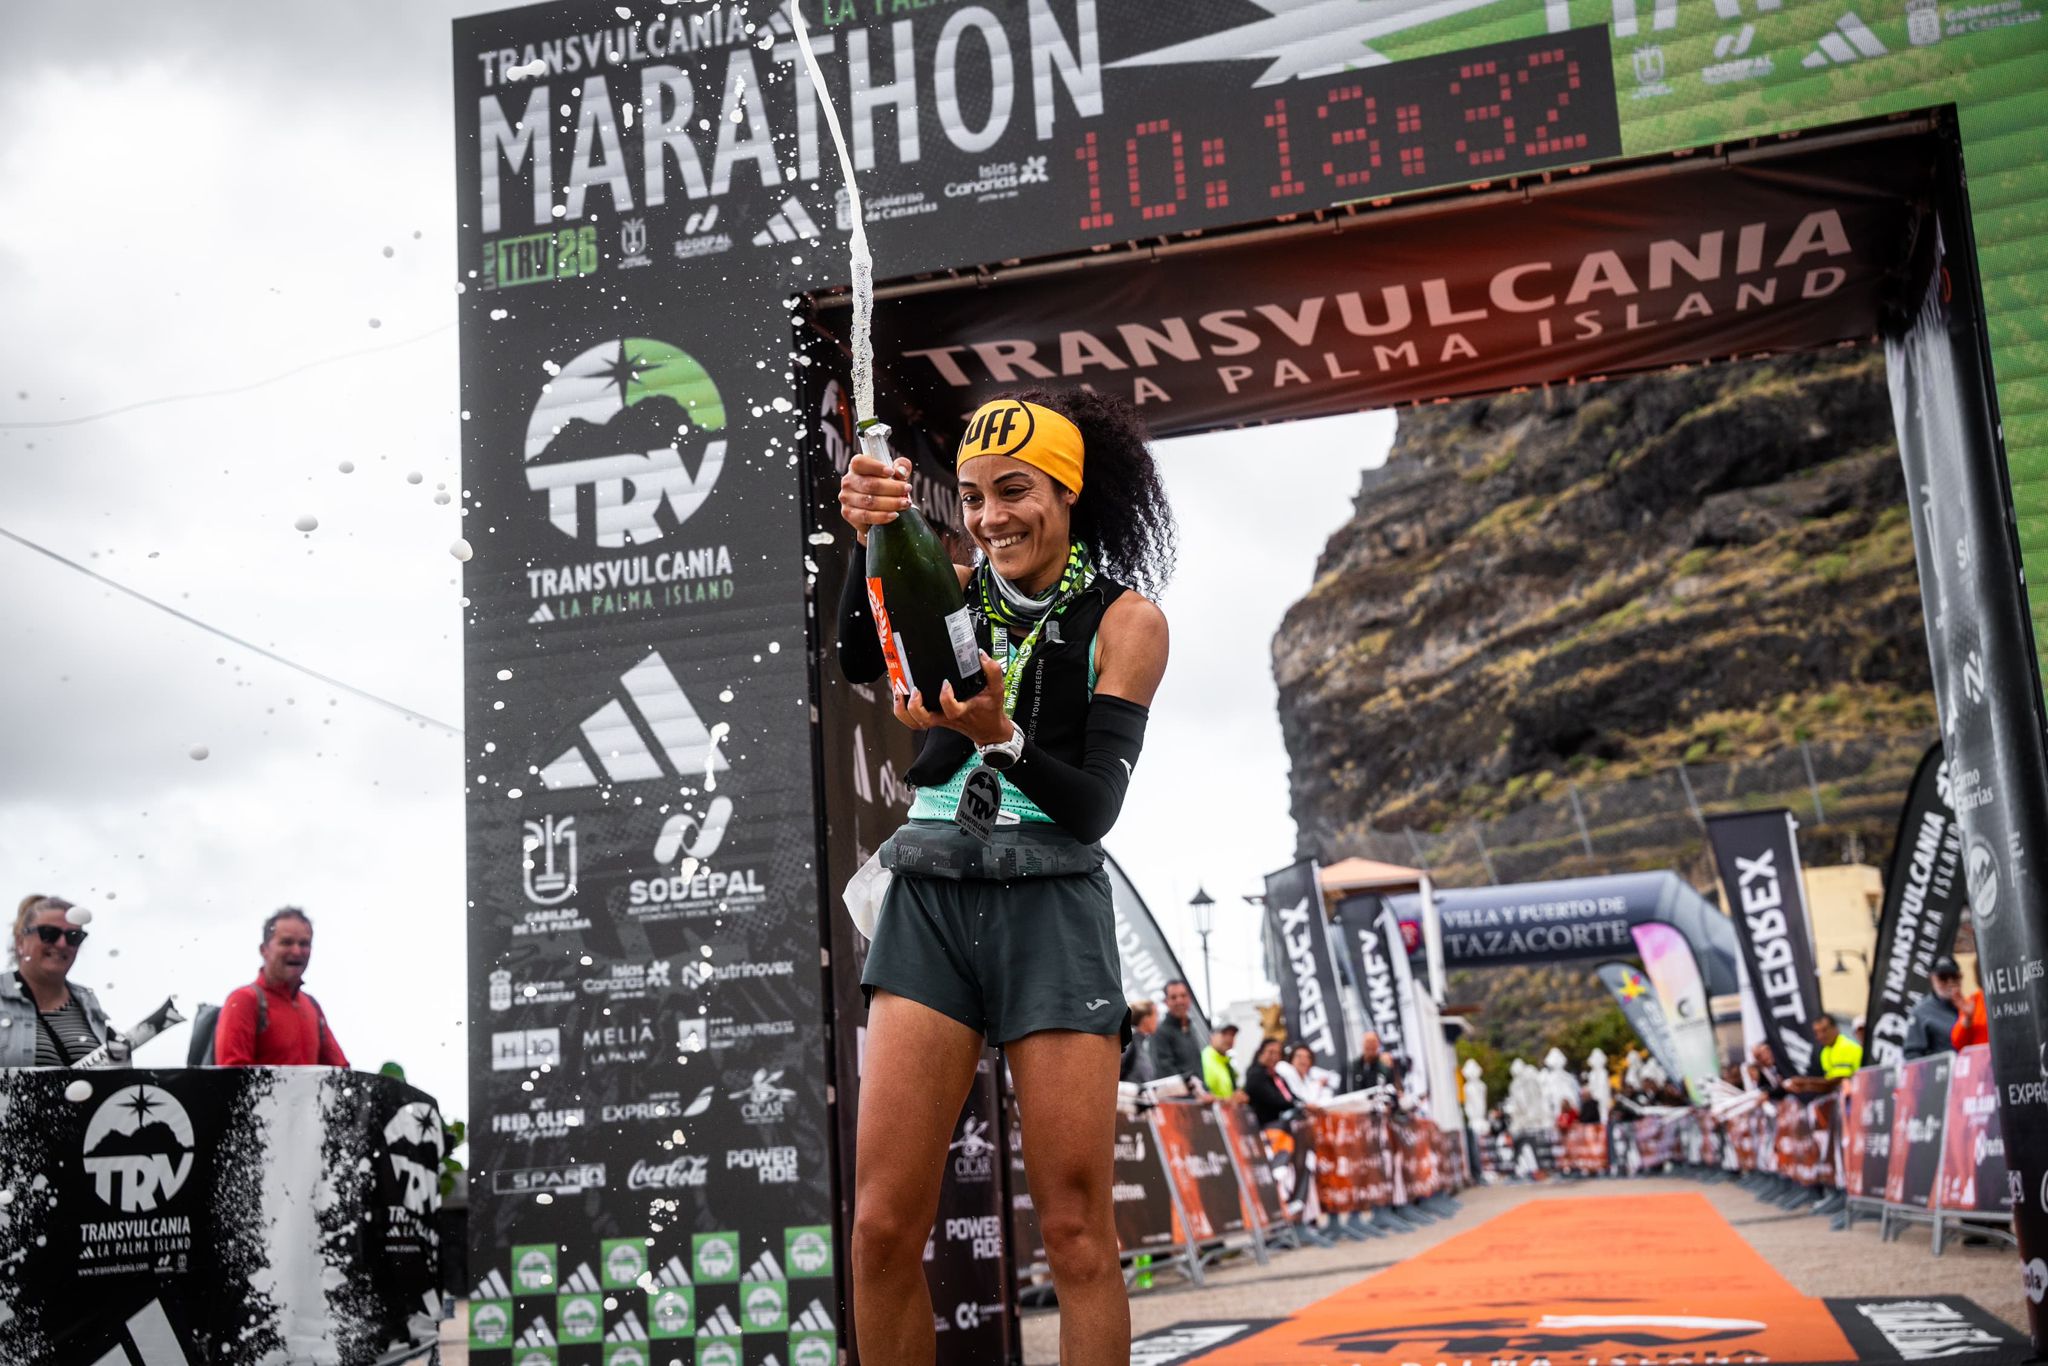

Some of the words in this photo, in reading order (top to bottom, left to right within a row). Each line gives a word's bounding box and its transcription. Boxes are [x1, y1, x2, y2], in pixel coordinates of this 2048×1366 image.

[479, 6, 748, 88] TRANSVULCANIA
[479, 0, 1105, 233] MARATHON
[978, 161, 1018, 179] Islas
[943, 173, 1019, 198] Canarias
[865, 191, 925, 210] Gobierno
[865, 209, 881, 222] de
[882, 201, 938, 220] Canarias
[903, 208, 1853, 387] TRANSVULCANIA
[1217, 332, 1479, 394] PALMA
[1538, 266, 1847, 348] ISLAND
[965, 407, 1021, 451] UFF
[527, 545, 734, 598] TRANSVULCANIA
[559, 599, 581, 620] LA
[592, 589, 653, 615] PALMA
[665, 579, 735, 606] ISLAND
[1035, 658, 1046, 694] FREEDOM
[1031, 696, 1041, 718] YOUR
[629, 868, 766, 905] SODEPAL
[524, 907, 579, 924] CABILDO
[1442, 909, 1500, 928] VILLA
[1501, 904, 1517, 925] Y
[1518, 899, 1597, 924] PUERTO
[1597, 895, 1627, 916] DE
[1882, 810, 1946, 1003] TRANSVULCANIA
[512, 924, 529, 936] DE
[531, 922, 548, 934] LA
[550, 918, 592, 932] PALMA
[1443, 919, 1631, 958] TAZACORTE
[1912, 908, 1944, 979] PALMA
[1992, 1004, 2002, 1019] LA
[2003, 1000, 2031, 1016] PALMA
[591, 1053, 606, 1065] LA
[608, 1049, 647, 1062] PALMA
[602, 1101, 682, 1122] EXPRESS
[727, 1145, 798, 1169] POWER
[954, 1156, 992, 1177] CICAR
[758, 1166, 799, 1183] ADE
[80, 1215, 191, 1243] TRANSVULCANIA
[946, 1215, 1001, 1241] POWER
[97, 1243, 110, 1258] LA
[115, 1239, 149, 1256] PALMA
[154, 1236, 191, 1252] ISLAND
[973, 1238, 1003, 1261] ADE
[77, 1261, 149, 1277] www.transvulcania.com
